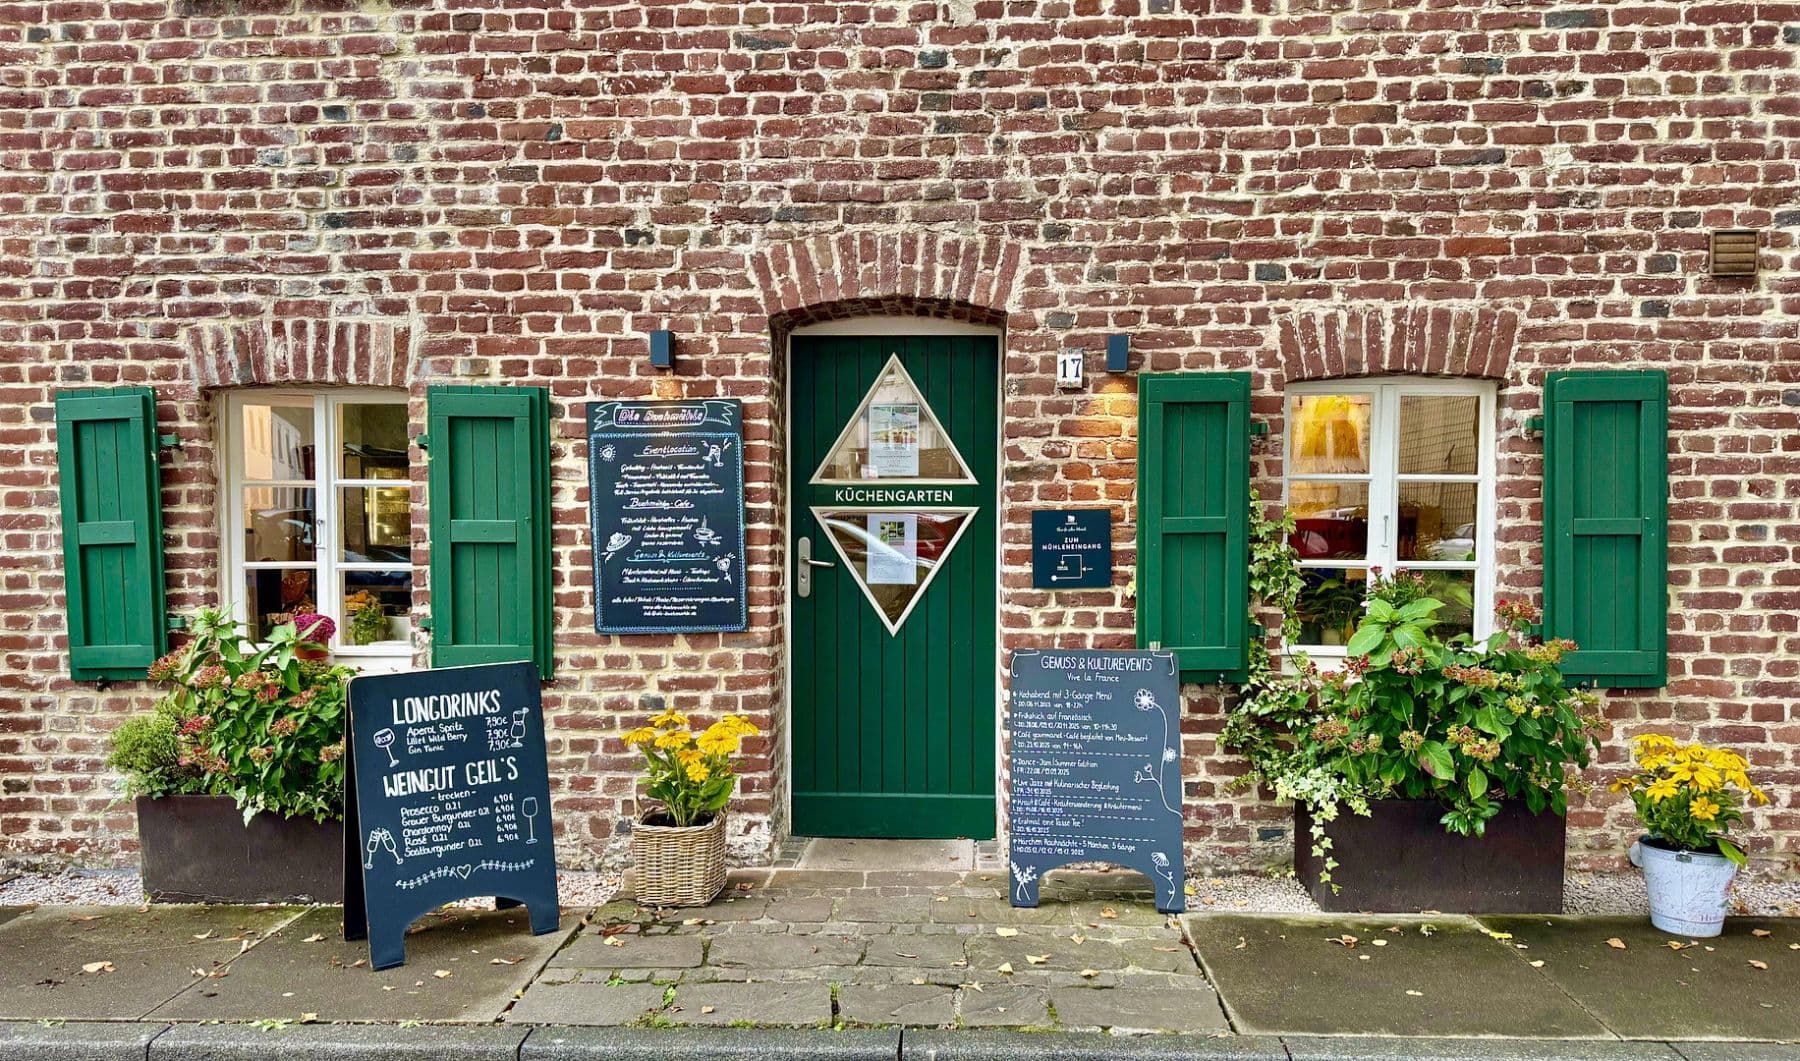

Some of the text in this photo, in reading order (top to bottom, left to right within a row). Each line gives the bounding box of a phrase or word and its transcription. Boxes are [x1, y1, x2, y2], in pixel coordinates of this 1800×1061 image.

[1060, 358, 1082, 378] 17
[643, 444, 697, 455] Eventlocation
[835, 487, 953, 502] KÜCHENGARTEN
[1042, 543, 1102, 551] MÜHLENEINGANG
[1040, 656, 1153, 672] GENUSS & KULTUREVENTS
[1066, 672, 1120, 682] Vive la France
[1019, 690, 1050, 699] Kochabend
[1052, 690, 1062, 699] mit
[392, 690, 501, 725] LONGDRINKS
[1046, 712, 1057, 720] auf
[439, 722, 464, 734] Spritz
[446, 732, 468, 742] Berry
[408, 745, 422, 755] Gin
[383, 765, 456, 798] WEINGUT
[1018, 778, 1028, 786] Live
[1029, 778, 1043, 787] Jazz
[437, 790, 471, 800] trocken
[400, 805, 440, 818] Prosecco
[1055, 818, 1071, 827] Tasse
[404, 834, 428, 847] Rosé
